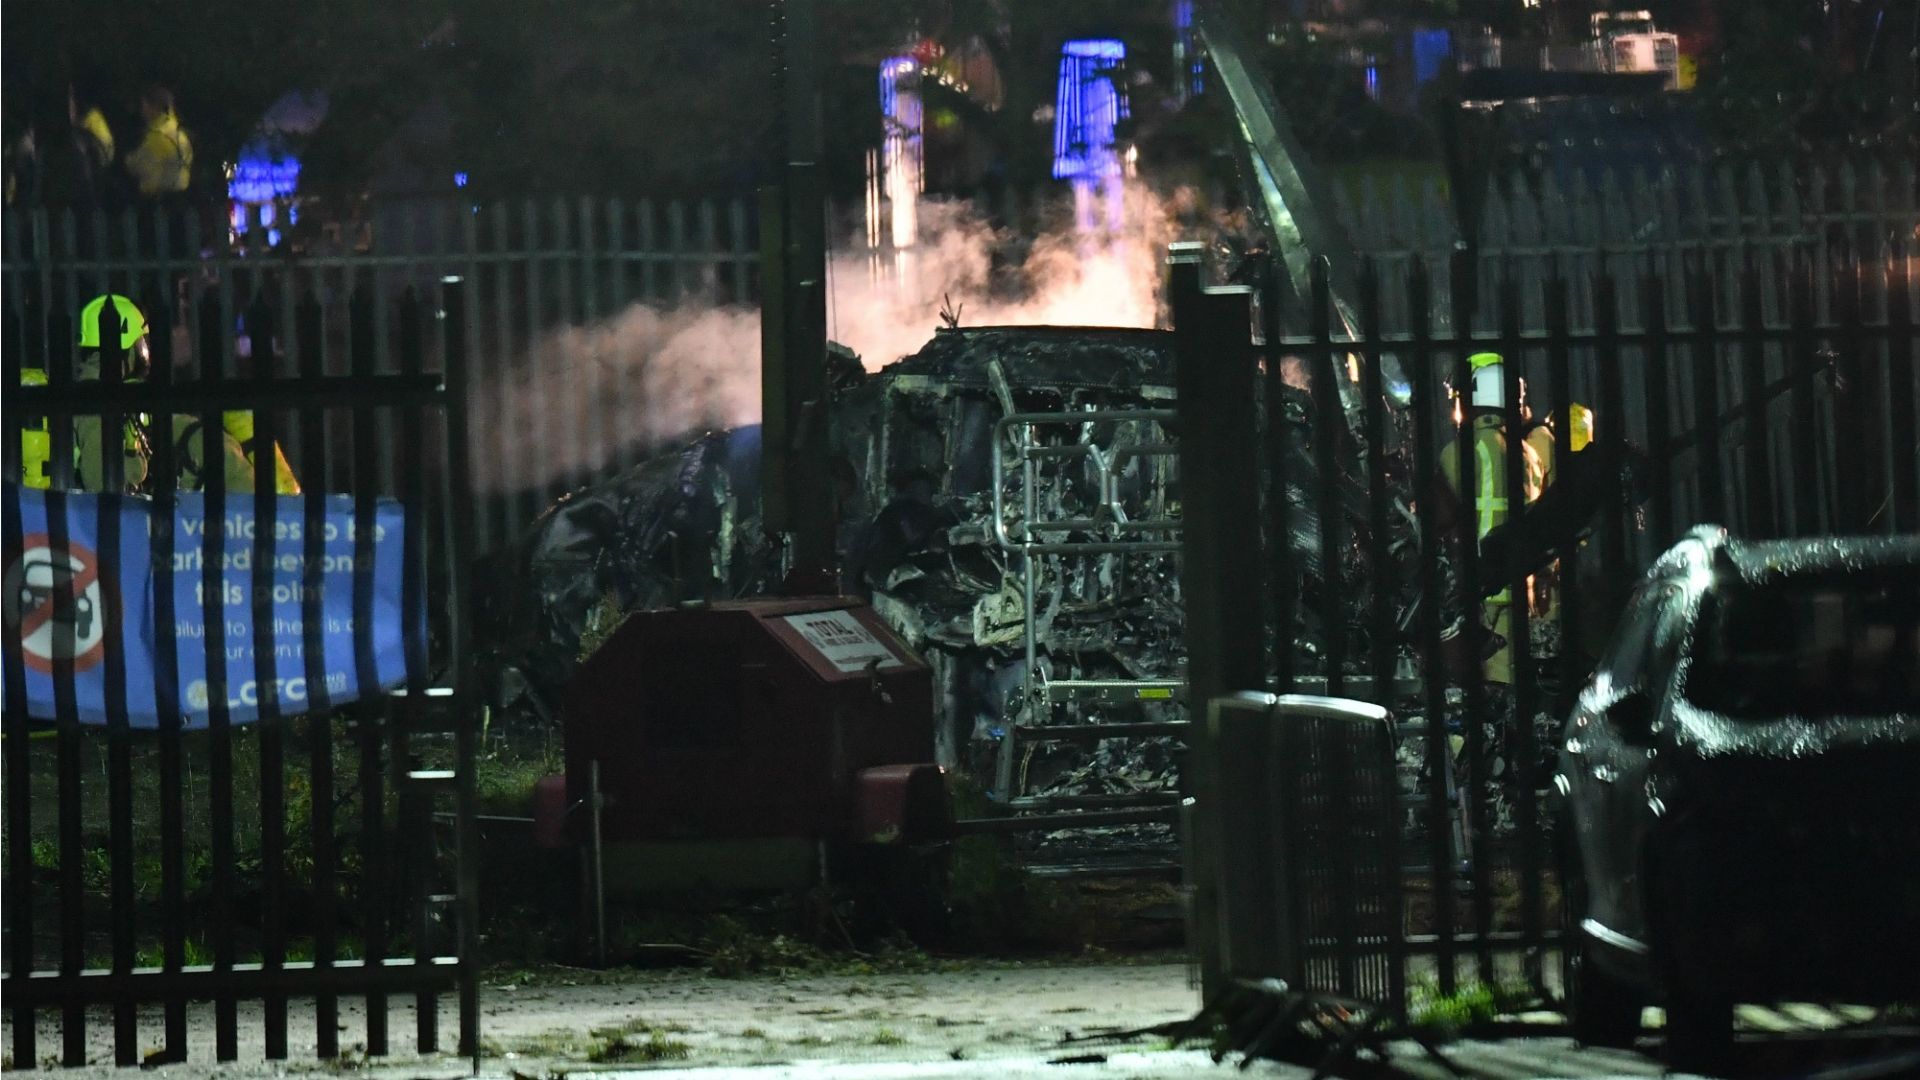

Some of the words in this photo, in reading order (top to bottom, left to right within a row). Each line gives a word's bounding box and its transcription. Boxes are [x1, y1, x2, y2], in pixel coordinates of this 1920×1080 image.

[181, 513, 301, 541] vehices
[155, 546, 250, 573] ared
[262, 548, 371, 578] beyon
[195, 579, 243, 605] tis
[226, 619, 247, 638] to
